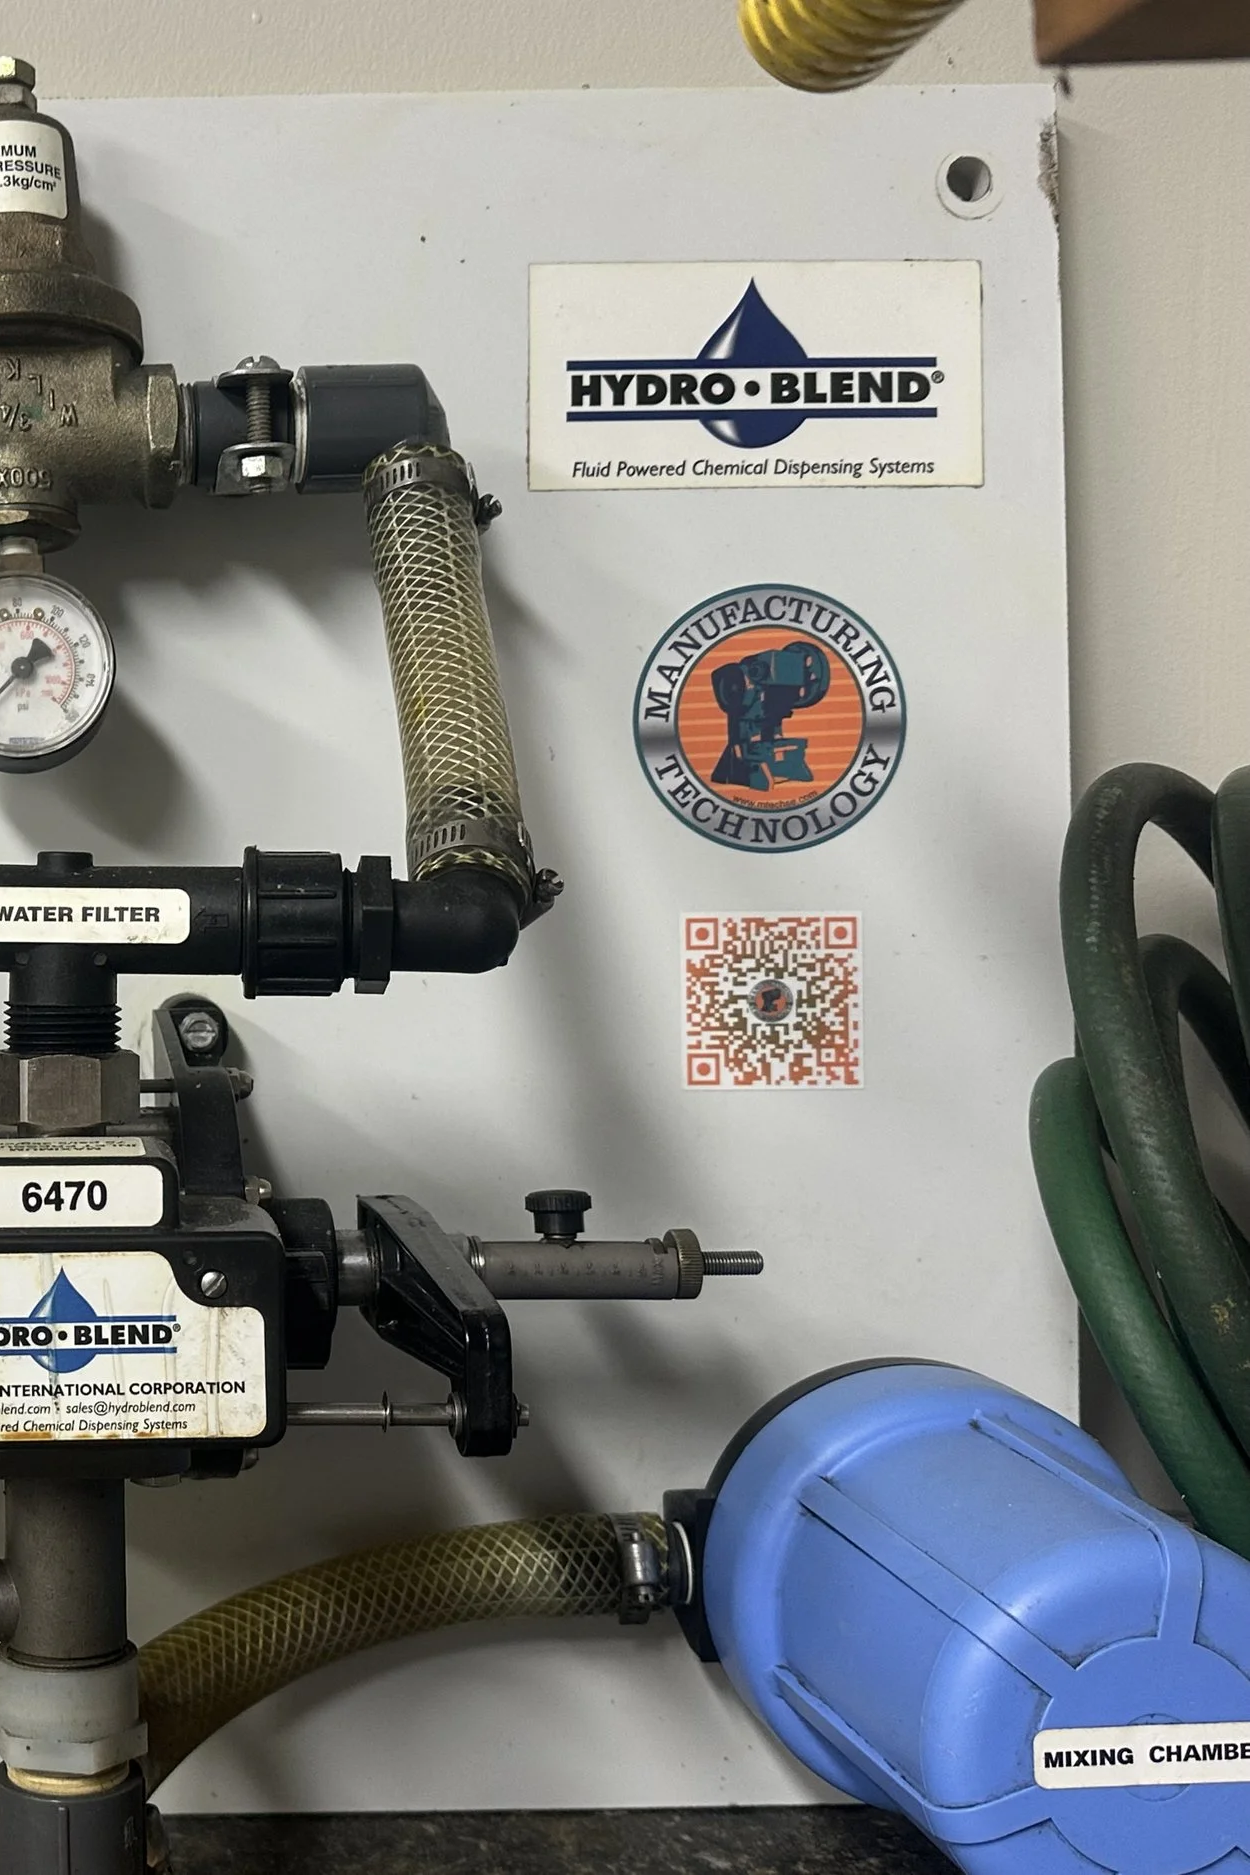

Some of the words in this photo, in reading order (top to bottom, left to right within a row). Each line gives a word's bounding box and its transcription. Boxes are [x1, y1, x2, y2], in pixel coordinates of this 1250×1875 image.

[571, 372, 735, 406] HYDRO
[572, 461, 610, 478] Fluid
[616, 459, 686, 477] Powered
[692, 458, 767, 476] Chemical
[774, 457, 863, 480] Dispensing
[869, 457, 935, 476] Systems
[12, 597, 22, 607] 80
[50, 605, 63, 617] 100
[78, 634, 91, 648] 120
[644, 595, 896, 723] MANUFACTURING
[17, 702, 29, 713] psi
[655, 744, 890, 843] TECHNOLOGY
[81, 906, 160, 923] FILTER
[21, 1180, 108, 1213] 6470
[129, 1380, 246, 1396] CORPORATION
[65, 1400, 196, 1416] sales@hydroblend.com
[23, 1418, 75, 1433] Chemical
[79, 1417, 139, 1435] Dispensing
[143, 1416, 188, 1431] Systems
[1044, 1748, 1134, 1768] MIXING
